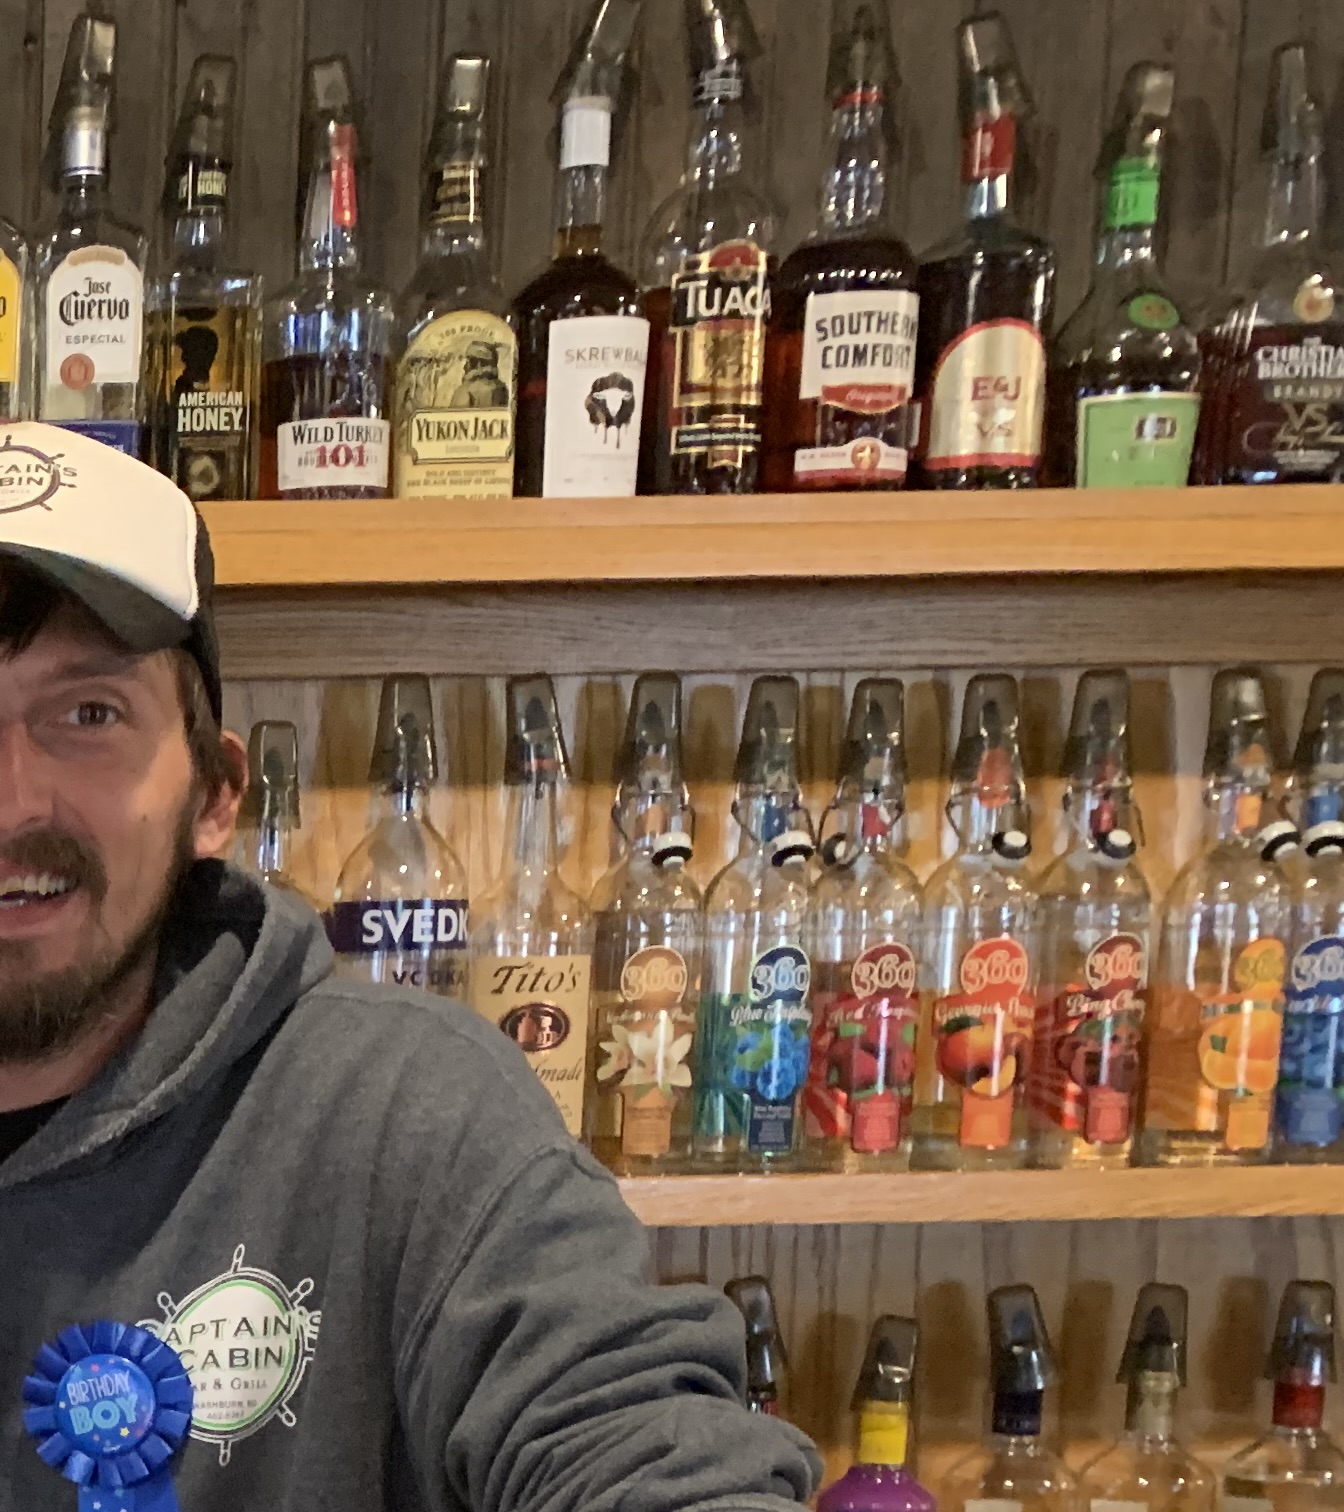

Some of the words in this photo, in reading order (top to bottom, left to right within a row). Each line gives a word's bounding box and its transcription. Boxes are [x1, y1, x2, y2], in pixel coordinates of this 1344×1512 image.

[82, 277, 112, 298] Jose
[679, 279, 773, 320] TUACA
[58, 290, 130, 327] Cuervo
[64, 334, 126, 345] ESPECIAL
[815, 311, 916, 343] SOUTHERN
[821, 343, 912, 371] COMFORT
[1254, 345, 1344, 361] CHRISTIA
[178, 391, 243, 406] AMERICAN
[971, 375, 1021, 401] E&J
[177, 407, 243, 433] HONEY
[291, 422, 335, 446] WILD
[336, 420, 385, 444] TURKEY
[415, 418, 469, 442] YUKON
[470, 417, 510, 441] JACK
[315, 445, 367, 469] 101
[361, 908, 469, 945] SVEDK
[490, 961, 582, 995] Tito's
[624, 957, 686, 1001] 360
[753, 956, 810, 1001] 360
[854, 953, 913, 998] 360
[962, 949, 1027, 994] 360
[1088, 943, 1146, 989] 360
[178, 1345, 285, 1373] CABIN
[66, 1371, 132, 1406] BIRTHDAY
[213, 1377, 223, 1391] &
[230, 1377, 268, 1391] GRILL
[69, 1396, 141, 1436] BOY
